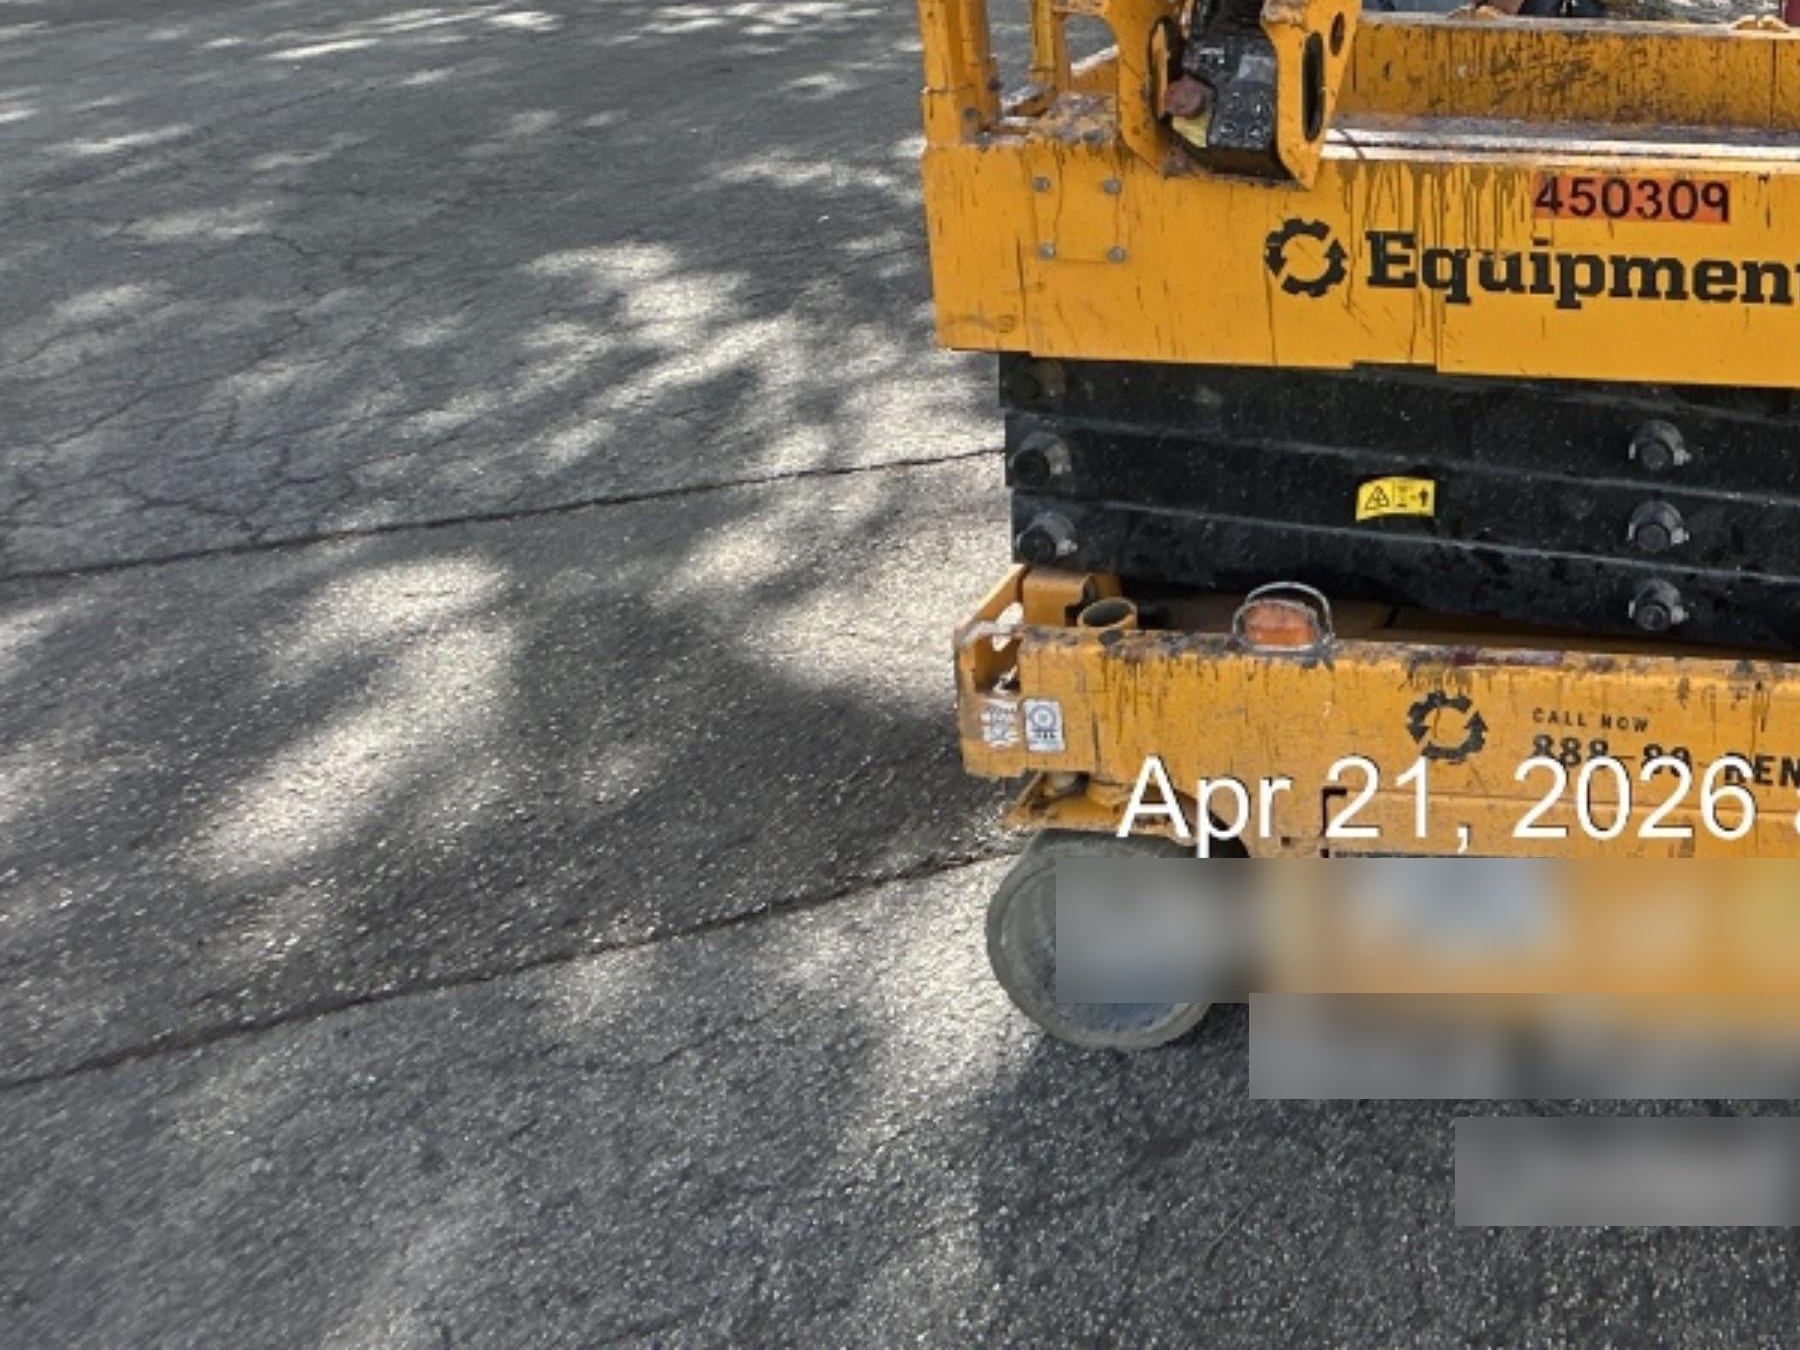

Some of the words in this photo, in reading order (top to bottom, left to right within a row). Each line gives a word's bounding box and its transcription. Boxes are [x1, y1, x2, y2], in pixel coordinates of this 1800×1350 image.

[1532, 173, 1732, 224] 450309
[1532, 707, 1588, 728] CALL
[1600, 714, 1649, 733] NOW
